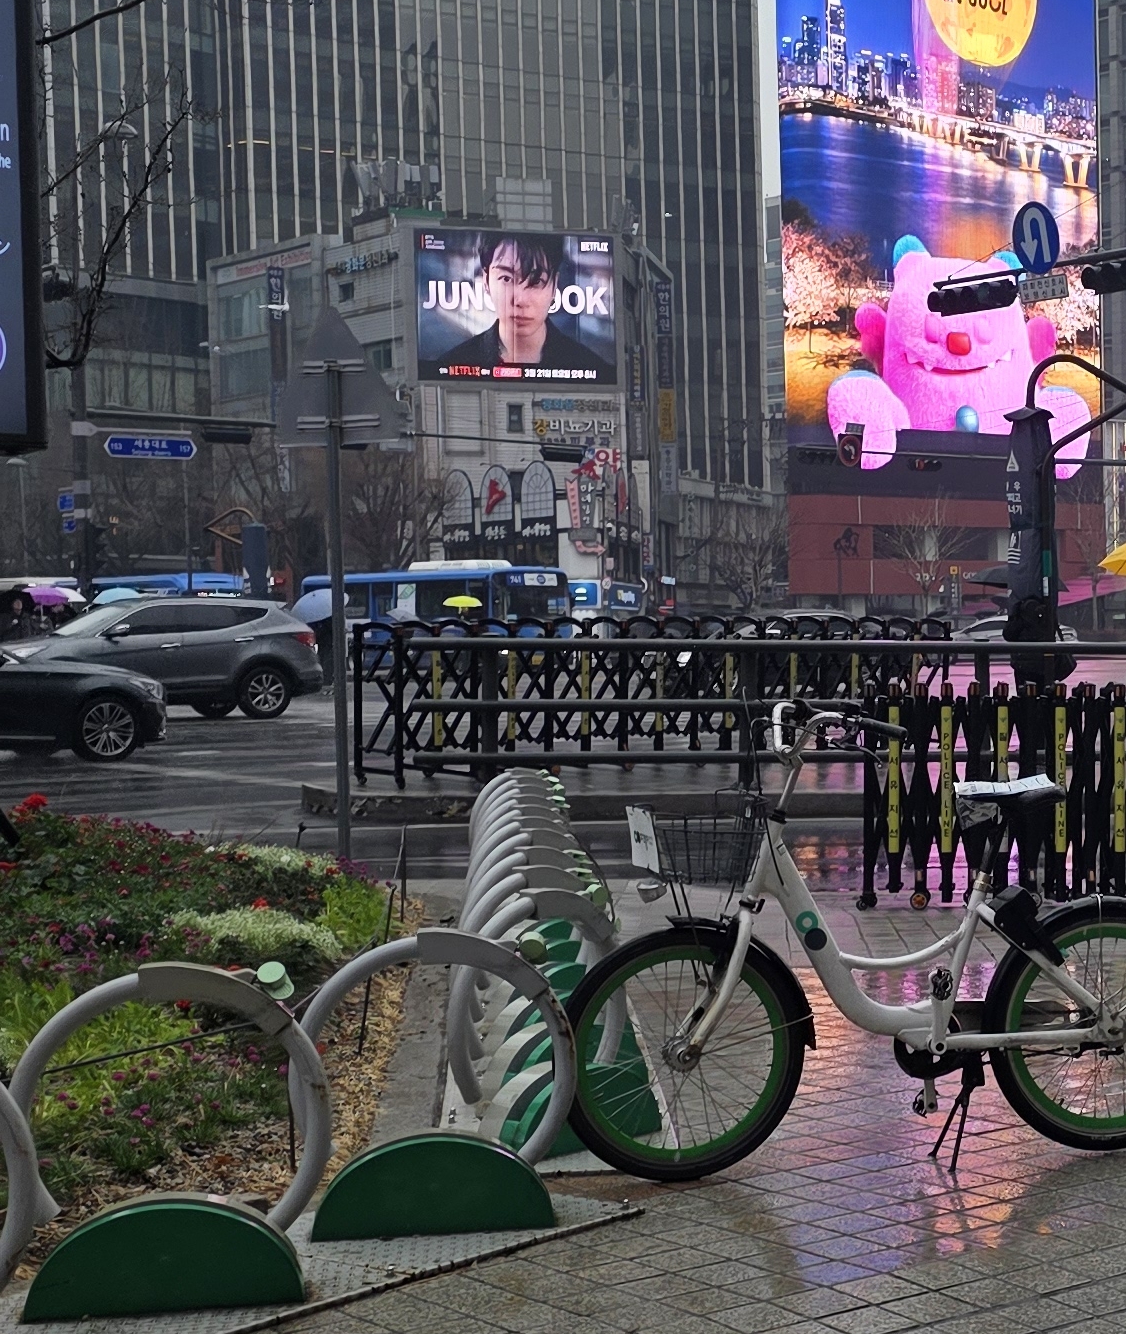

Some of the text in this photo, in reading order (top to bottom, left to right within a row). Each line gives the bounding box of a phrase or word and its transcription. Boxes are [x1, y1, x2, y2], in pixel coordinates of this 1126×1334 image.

[533, 418, 617, 437] 강비뇨기과
[942, 733, 951, 838] POLICE LINE
